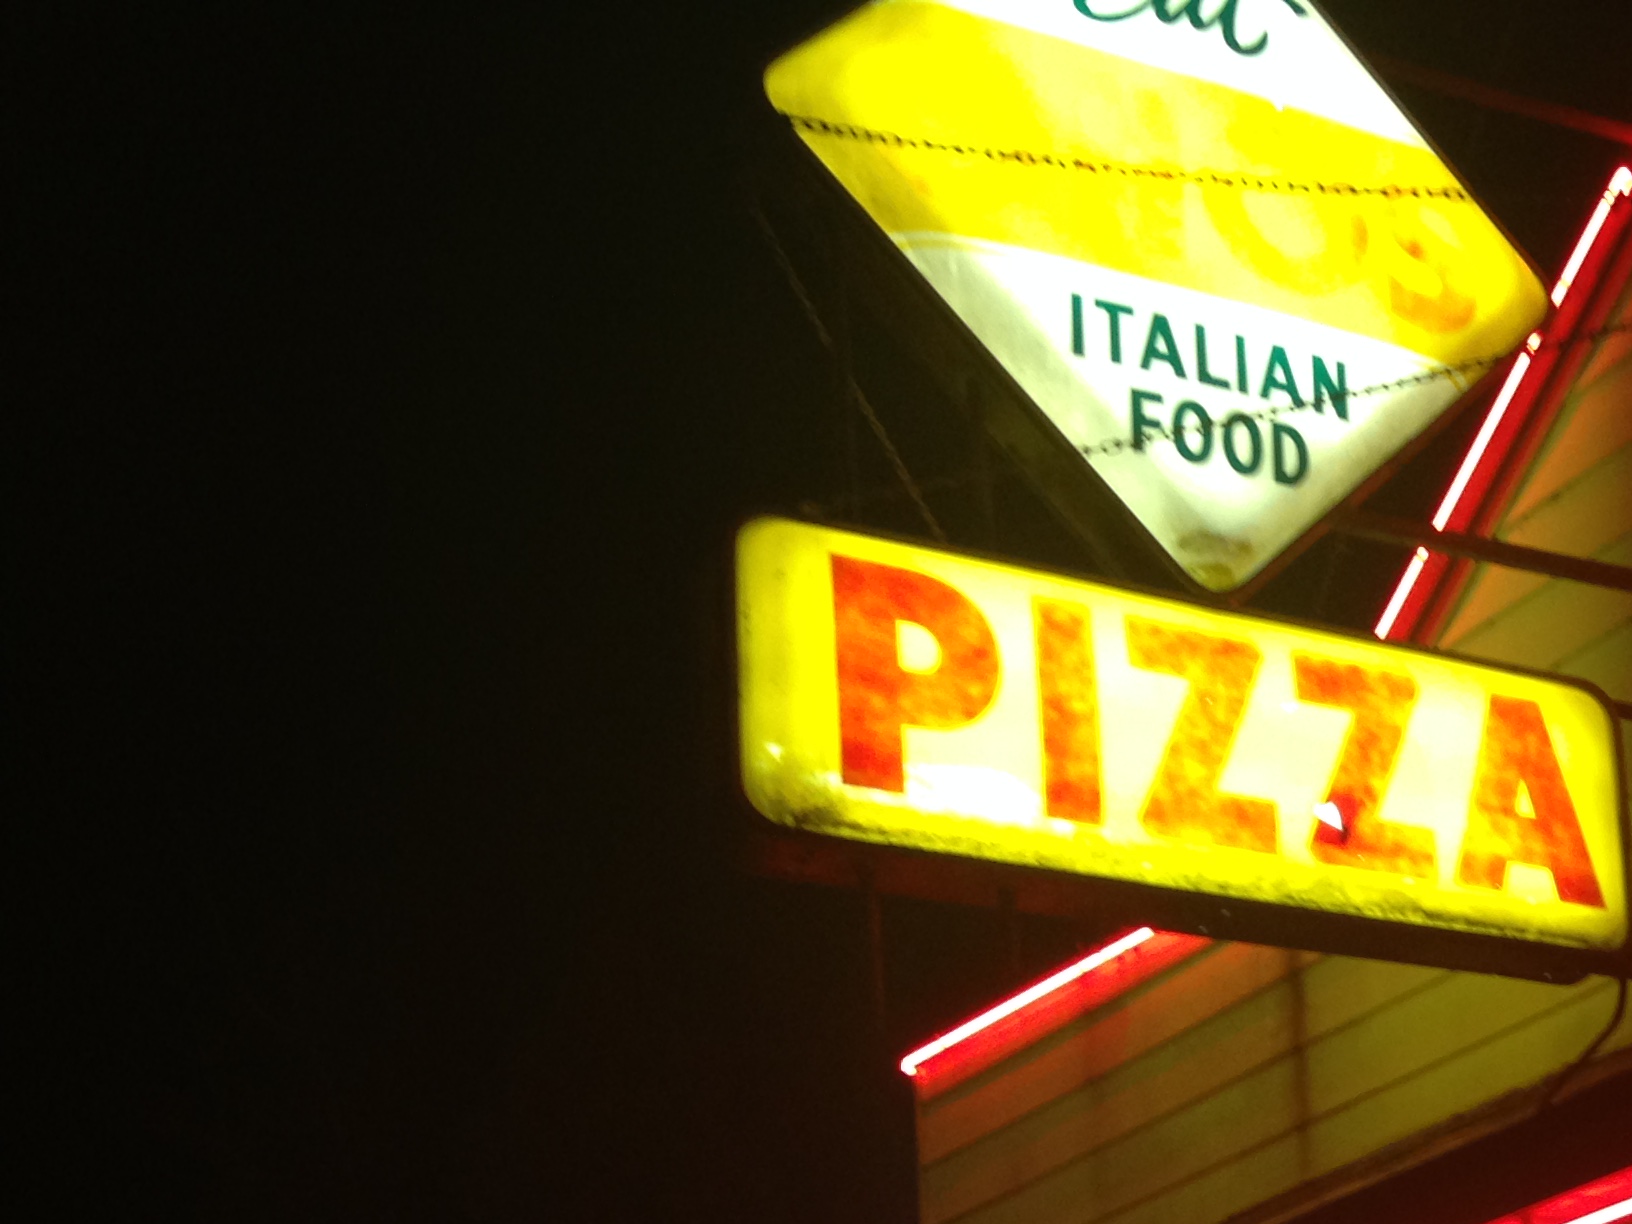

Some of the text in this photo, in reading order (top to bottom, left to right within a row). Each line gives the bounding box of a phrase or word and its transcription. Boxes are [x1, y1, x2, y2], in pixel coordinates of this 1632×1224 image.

[1070, 293, 1350, 422] ITALIAN
[1130, 390, 1309, 486] FOOD
[829, 552, 1607, 909] PIZZA
